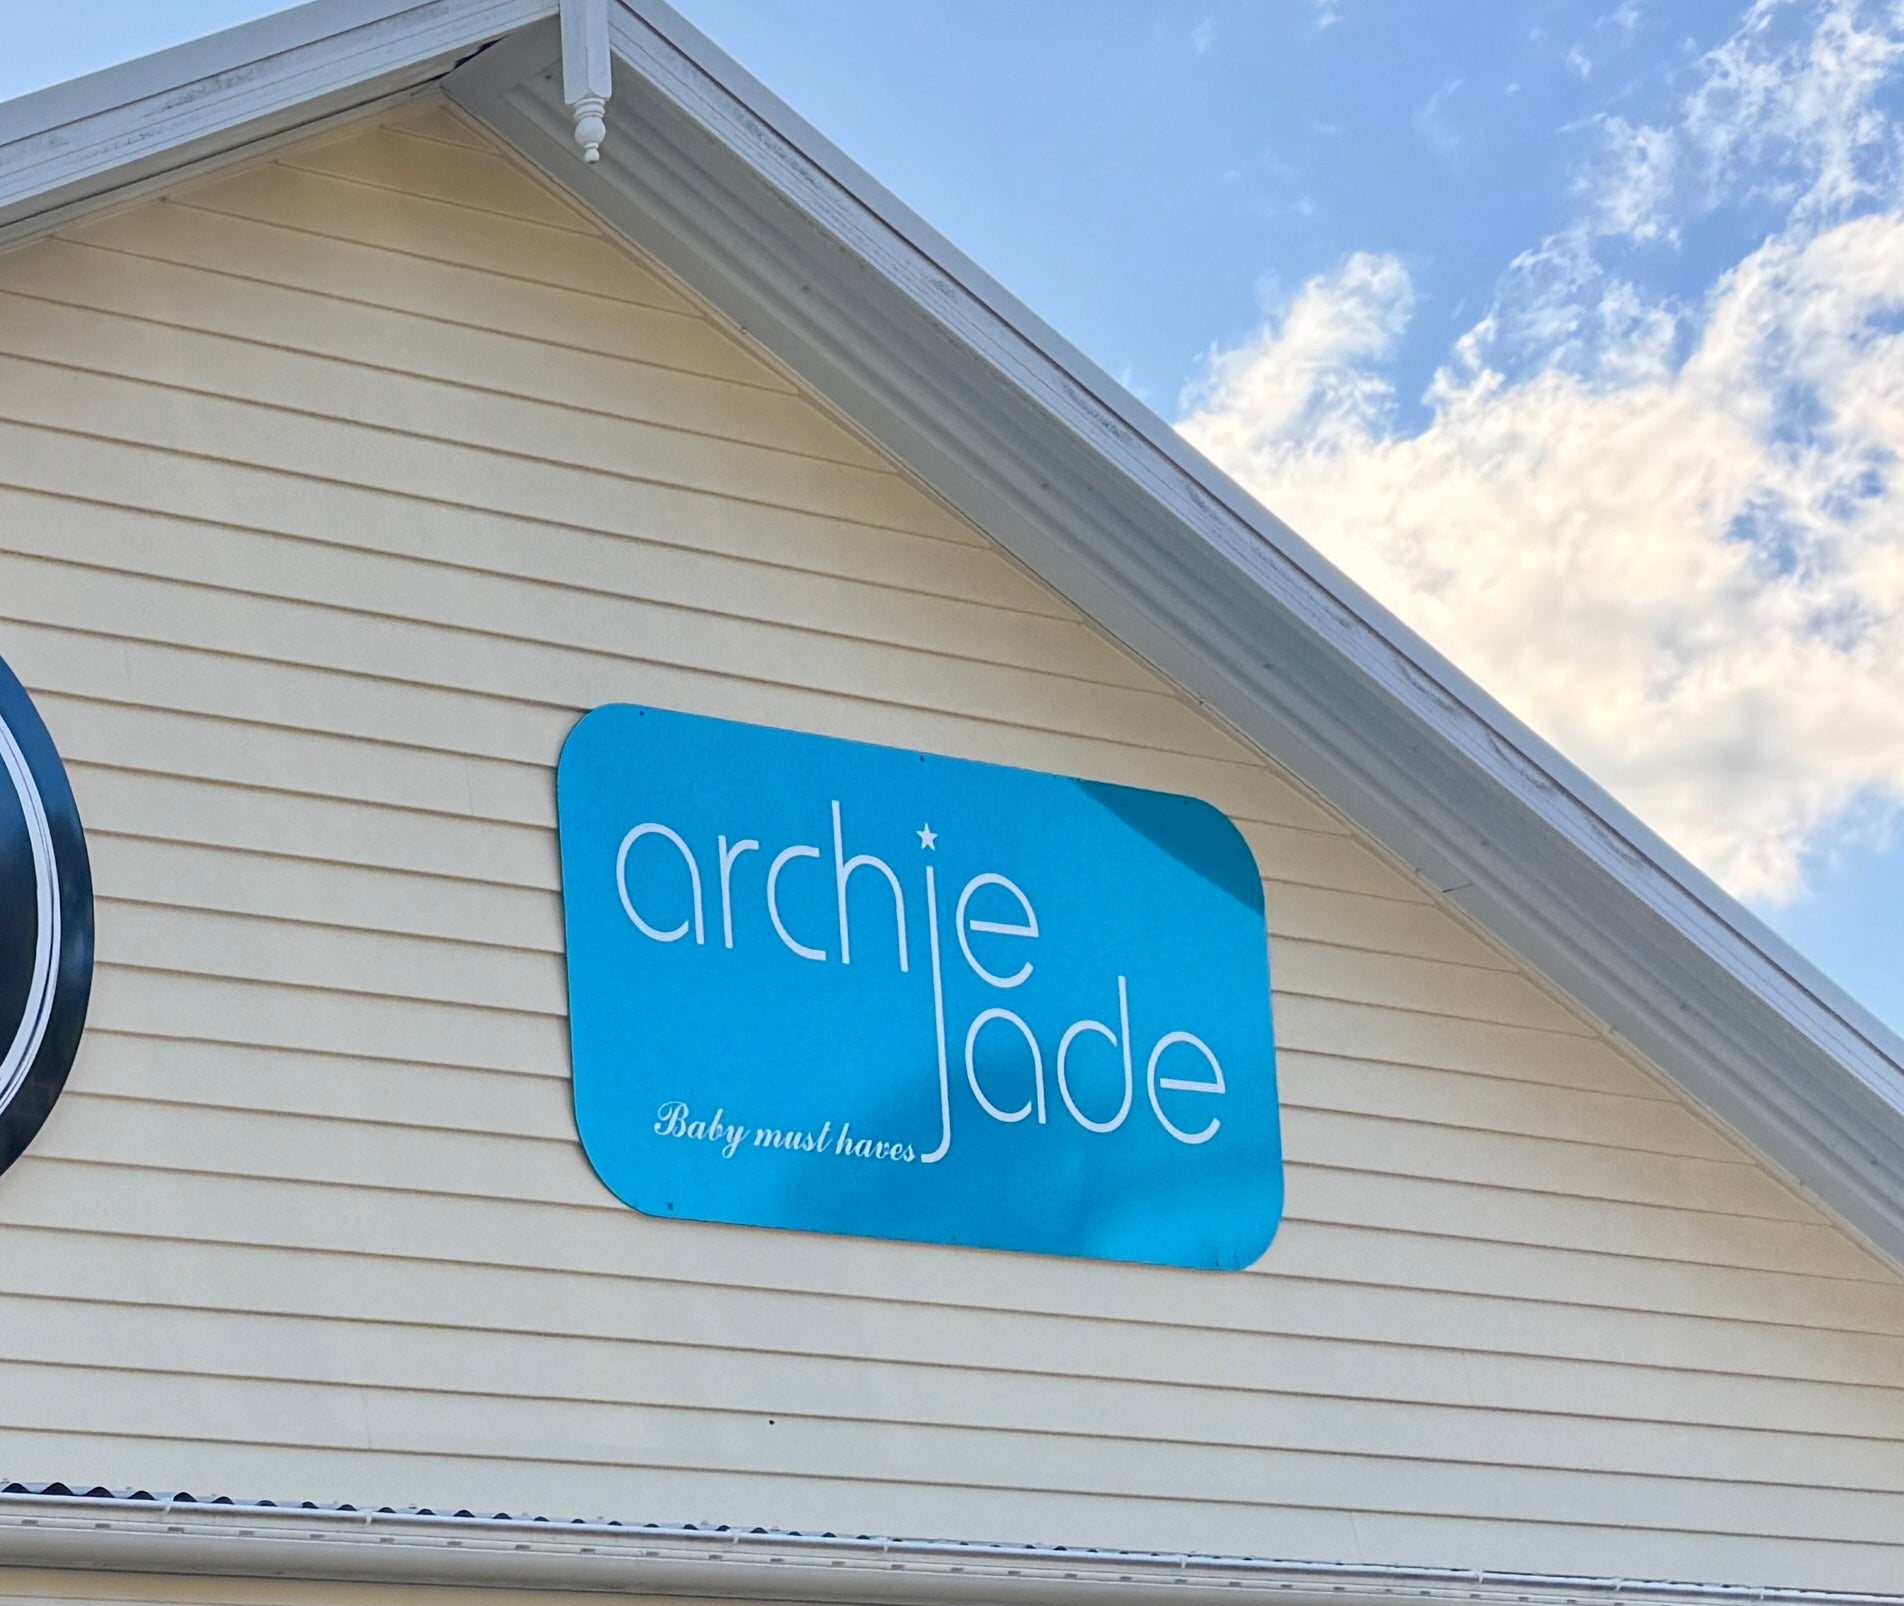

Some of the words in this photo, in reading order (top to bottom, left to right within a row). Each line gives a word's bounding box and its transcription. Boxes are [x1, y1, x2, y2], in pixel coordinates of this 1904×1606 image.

[654, 1100, 749, 1159] Baby
[753, 1121, 832, 1153] must
[835, 1122, 917, 1162] haves
